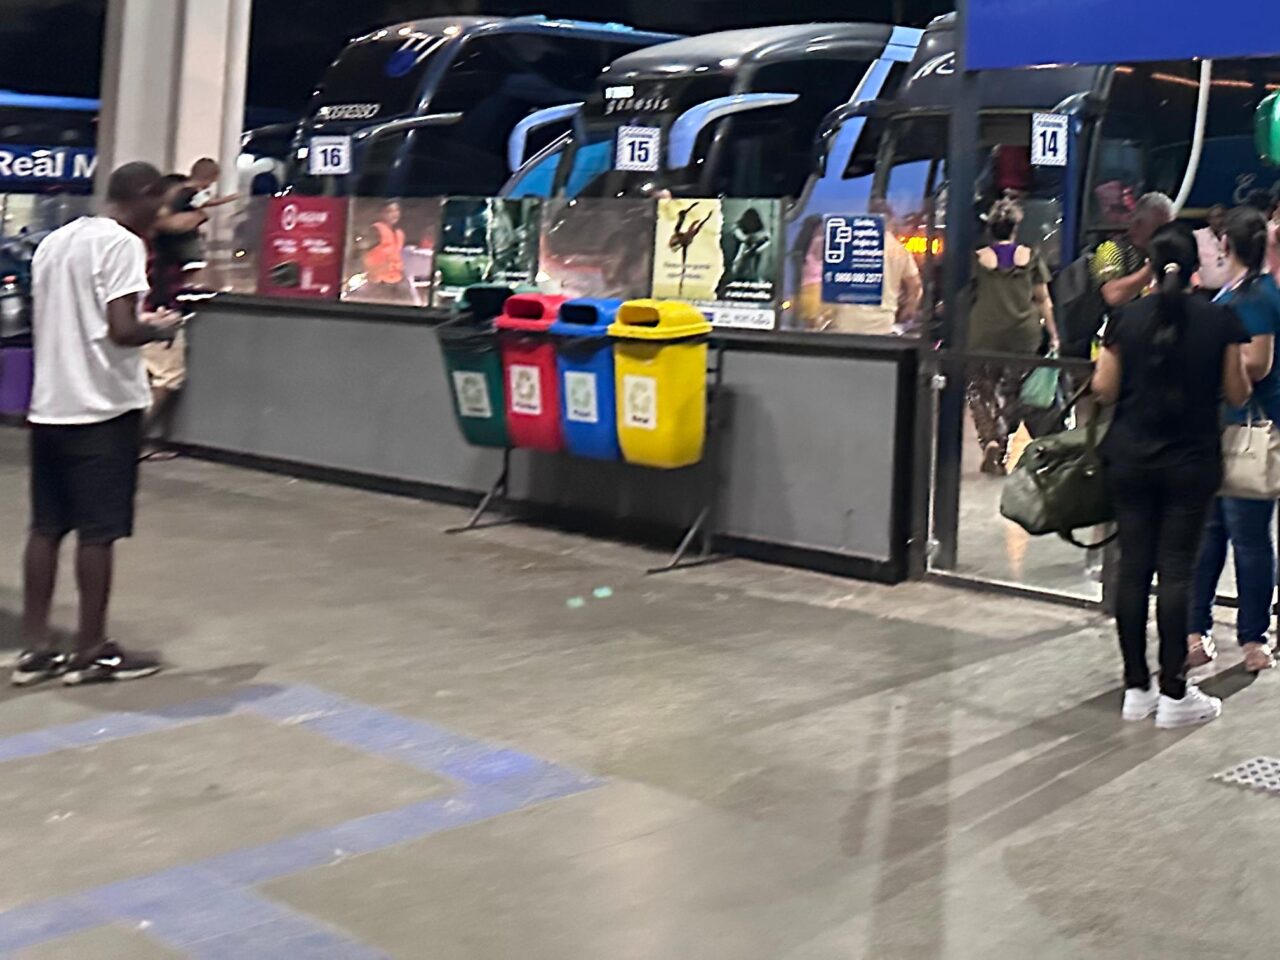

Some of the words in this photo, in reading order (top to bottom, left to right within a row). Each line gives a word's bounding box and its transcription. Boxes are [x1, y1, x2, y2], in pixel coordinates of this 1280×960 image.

[627, 139, 650, 163] 15
[1039, 130, 1059, 157] 14
[73, 153, 99, 178] M
[319, 147, 342, 167] 16
